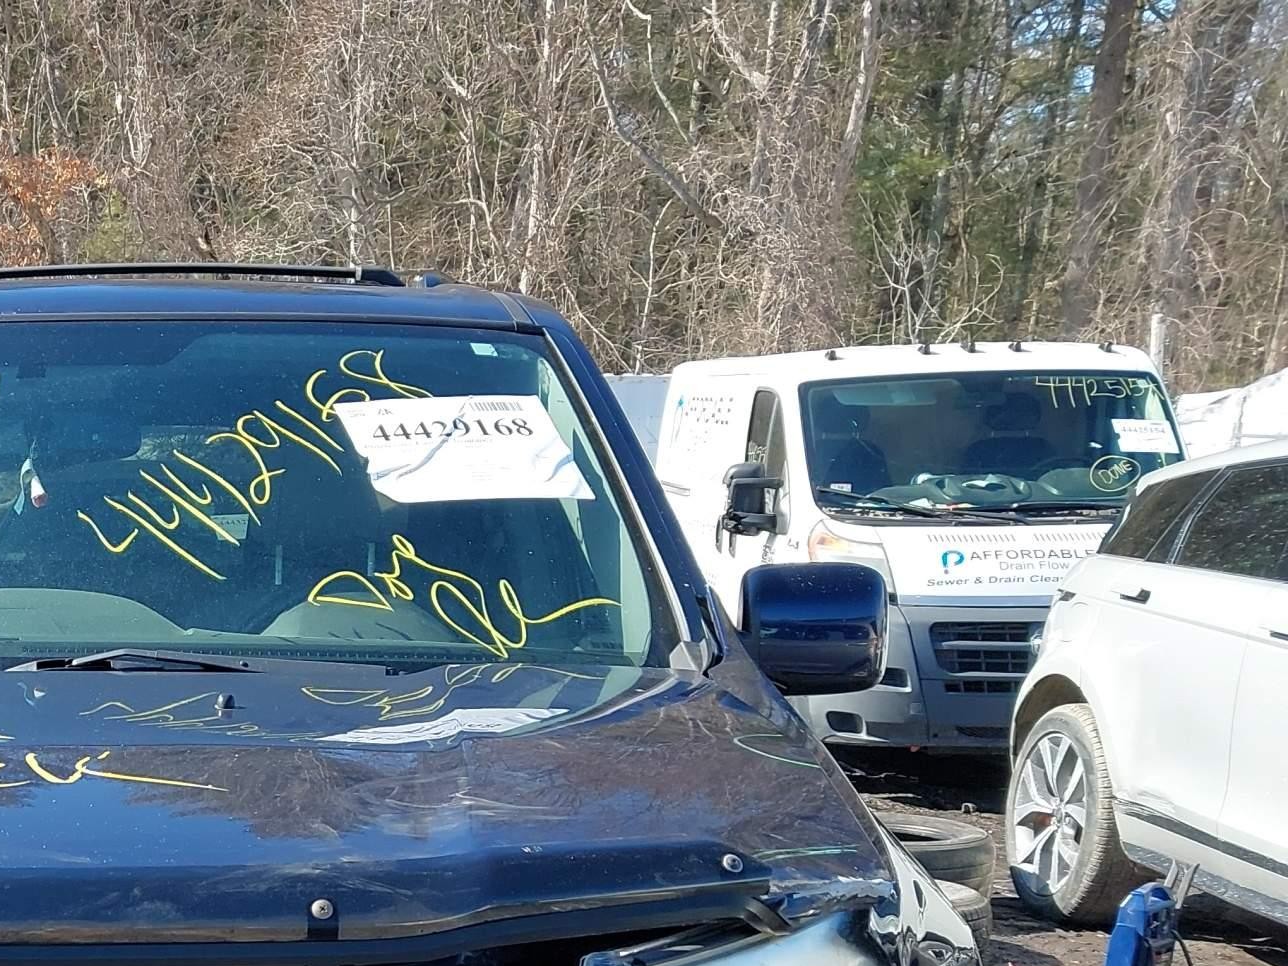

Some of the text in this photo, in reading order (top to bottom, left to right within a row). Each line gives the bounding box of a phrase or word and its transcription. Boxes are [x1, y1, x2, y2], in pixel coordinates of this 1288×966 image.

[372, 417, 534, 442] 44429168
[76, 350, 434, 582] 44429168
[1098, 460, 1133, 485] DONE
[970, 549, 1096, 561] AFFORDABLE
[999, 560, 1070, 571] Drain Flow
[927, 577, 969, 587] Sewer
[974, 576, 984, 584] &
[988, 575, 1025, 584] Drain
